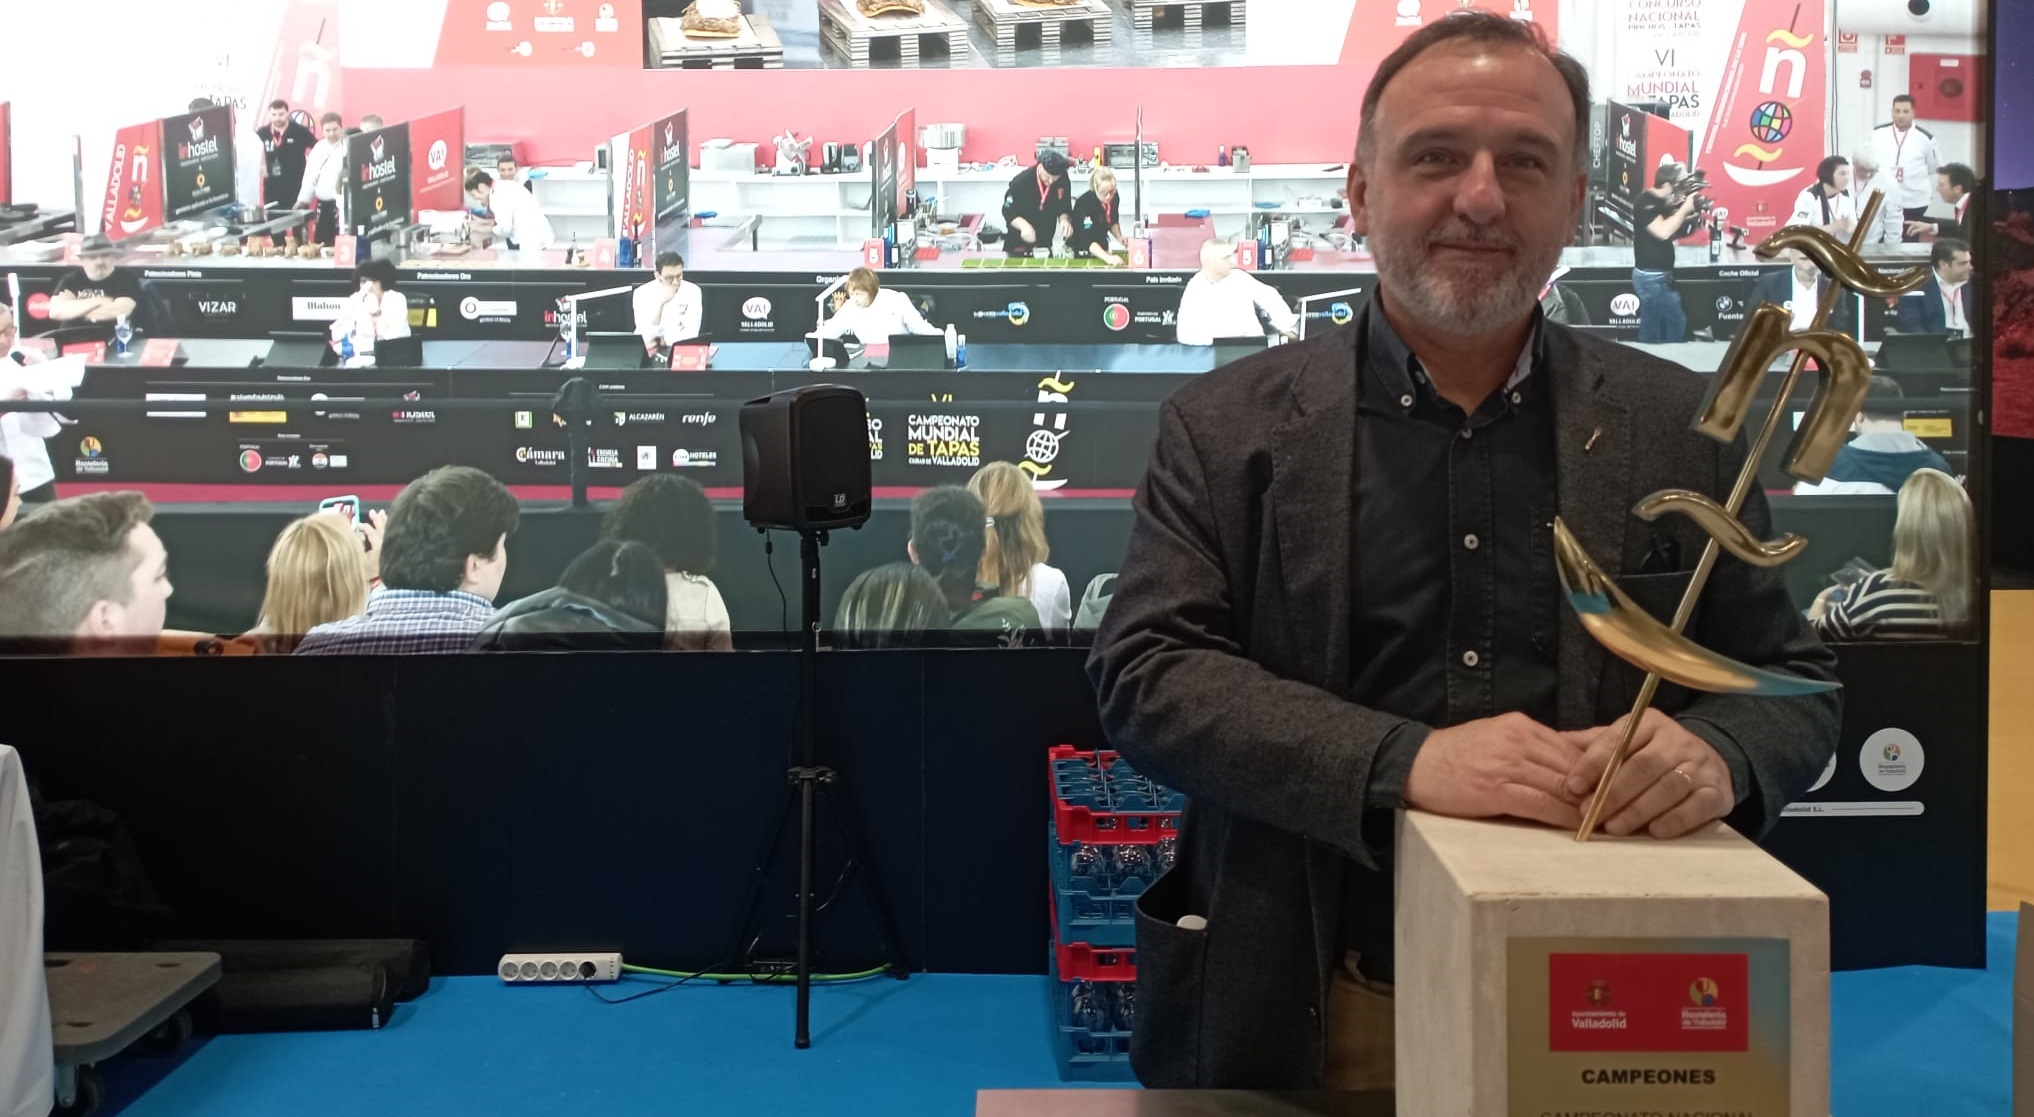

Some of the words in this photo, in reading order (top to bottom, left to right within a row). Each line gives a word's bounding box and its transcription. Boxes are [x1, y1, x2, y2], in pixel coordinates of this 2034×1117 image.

[1628, 11, 1700, 22] NACIONAL
[1654, 48, 1675, 67] VI
[1627, 80, 1700, 96] MUNDIAL
[199, 301, 237, 313] VIZAR
[745, 303, 768, 314] VA!
[1614, 299, 1636, 311] VA!
[682, 411, 716, 426] renfe
[907, 414, 980, 427] CAMPEONATO
[907, 426, 980, 442] MUNDIAL
[516, 446, 565, 462] Cámara
[908, 443, 925, 455] DE
[926, 440, 980, 456] TAPAS
[931, 456, 980, 467] VALLADOLID
[1571, 1018, 1628, 1030] Valladolid
[1581, 1069, 1717, 1085] CAMPEONES
